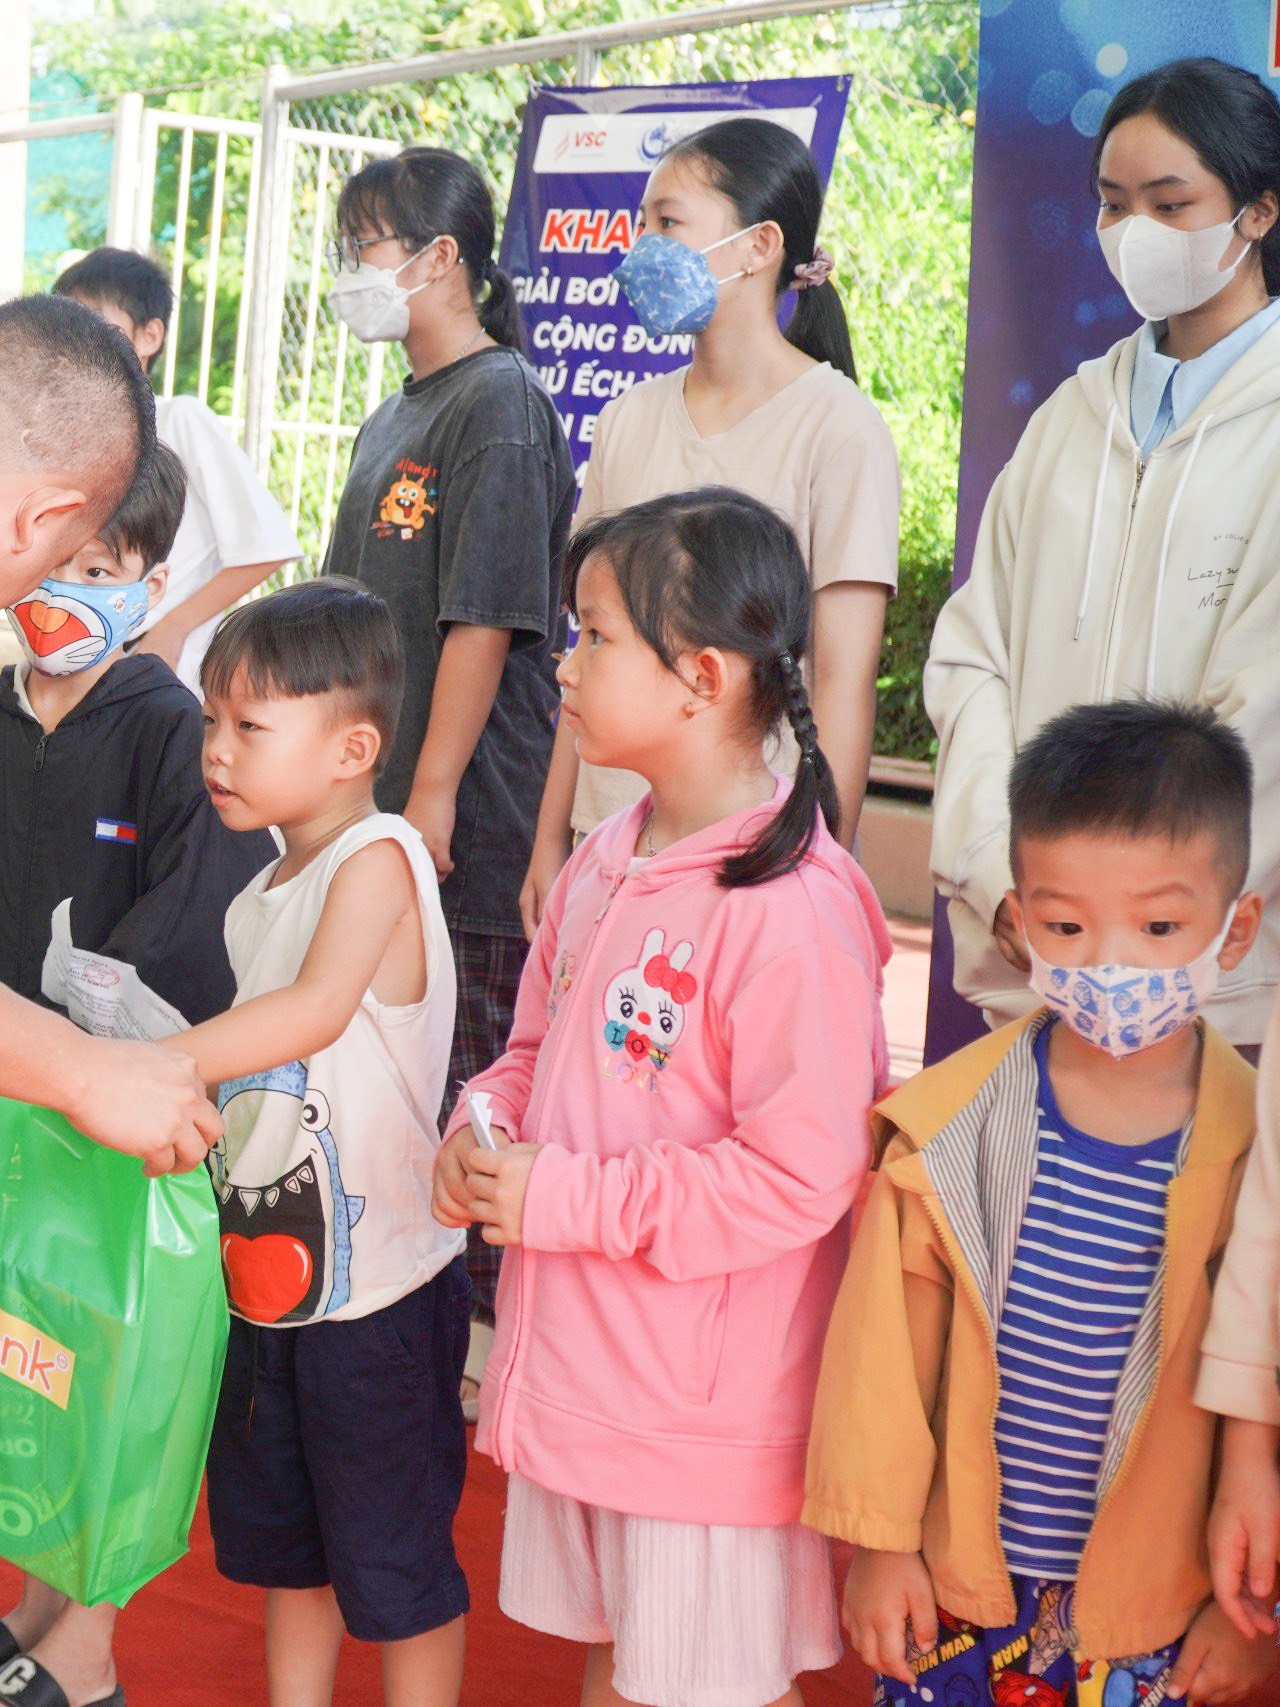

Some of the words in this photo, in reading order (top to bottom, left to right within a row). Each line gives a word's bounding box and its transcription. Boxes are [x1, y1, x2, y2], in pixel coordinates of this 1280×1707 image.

[575, 130, 608, 148] VSC
[539, 208, 645, 254] KHA
[533, 314, 618, 356] CỘNG
[1187, 567, 1222, 584] Lazy
[912, 1649, 938, 1676] RON
[940, 1632, 977, 1663] MAN
